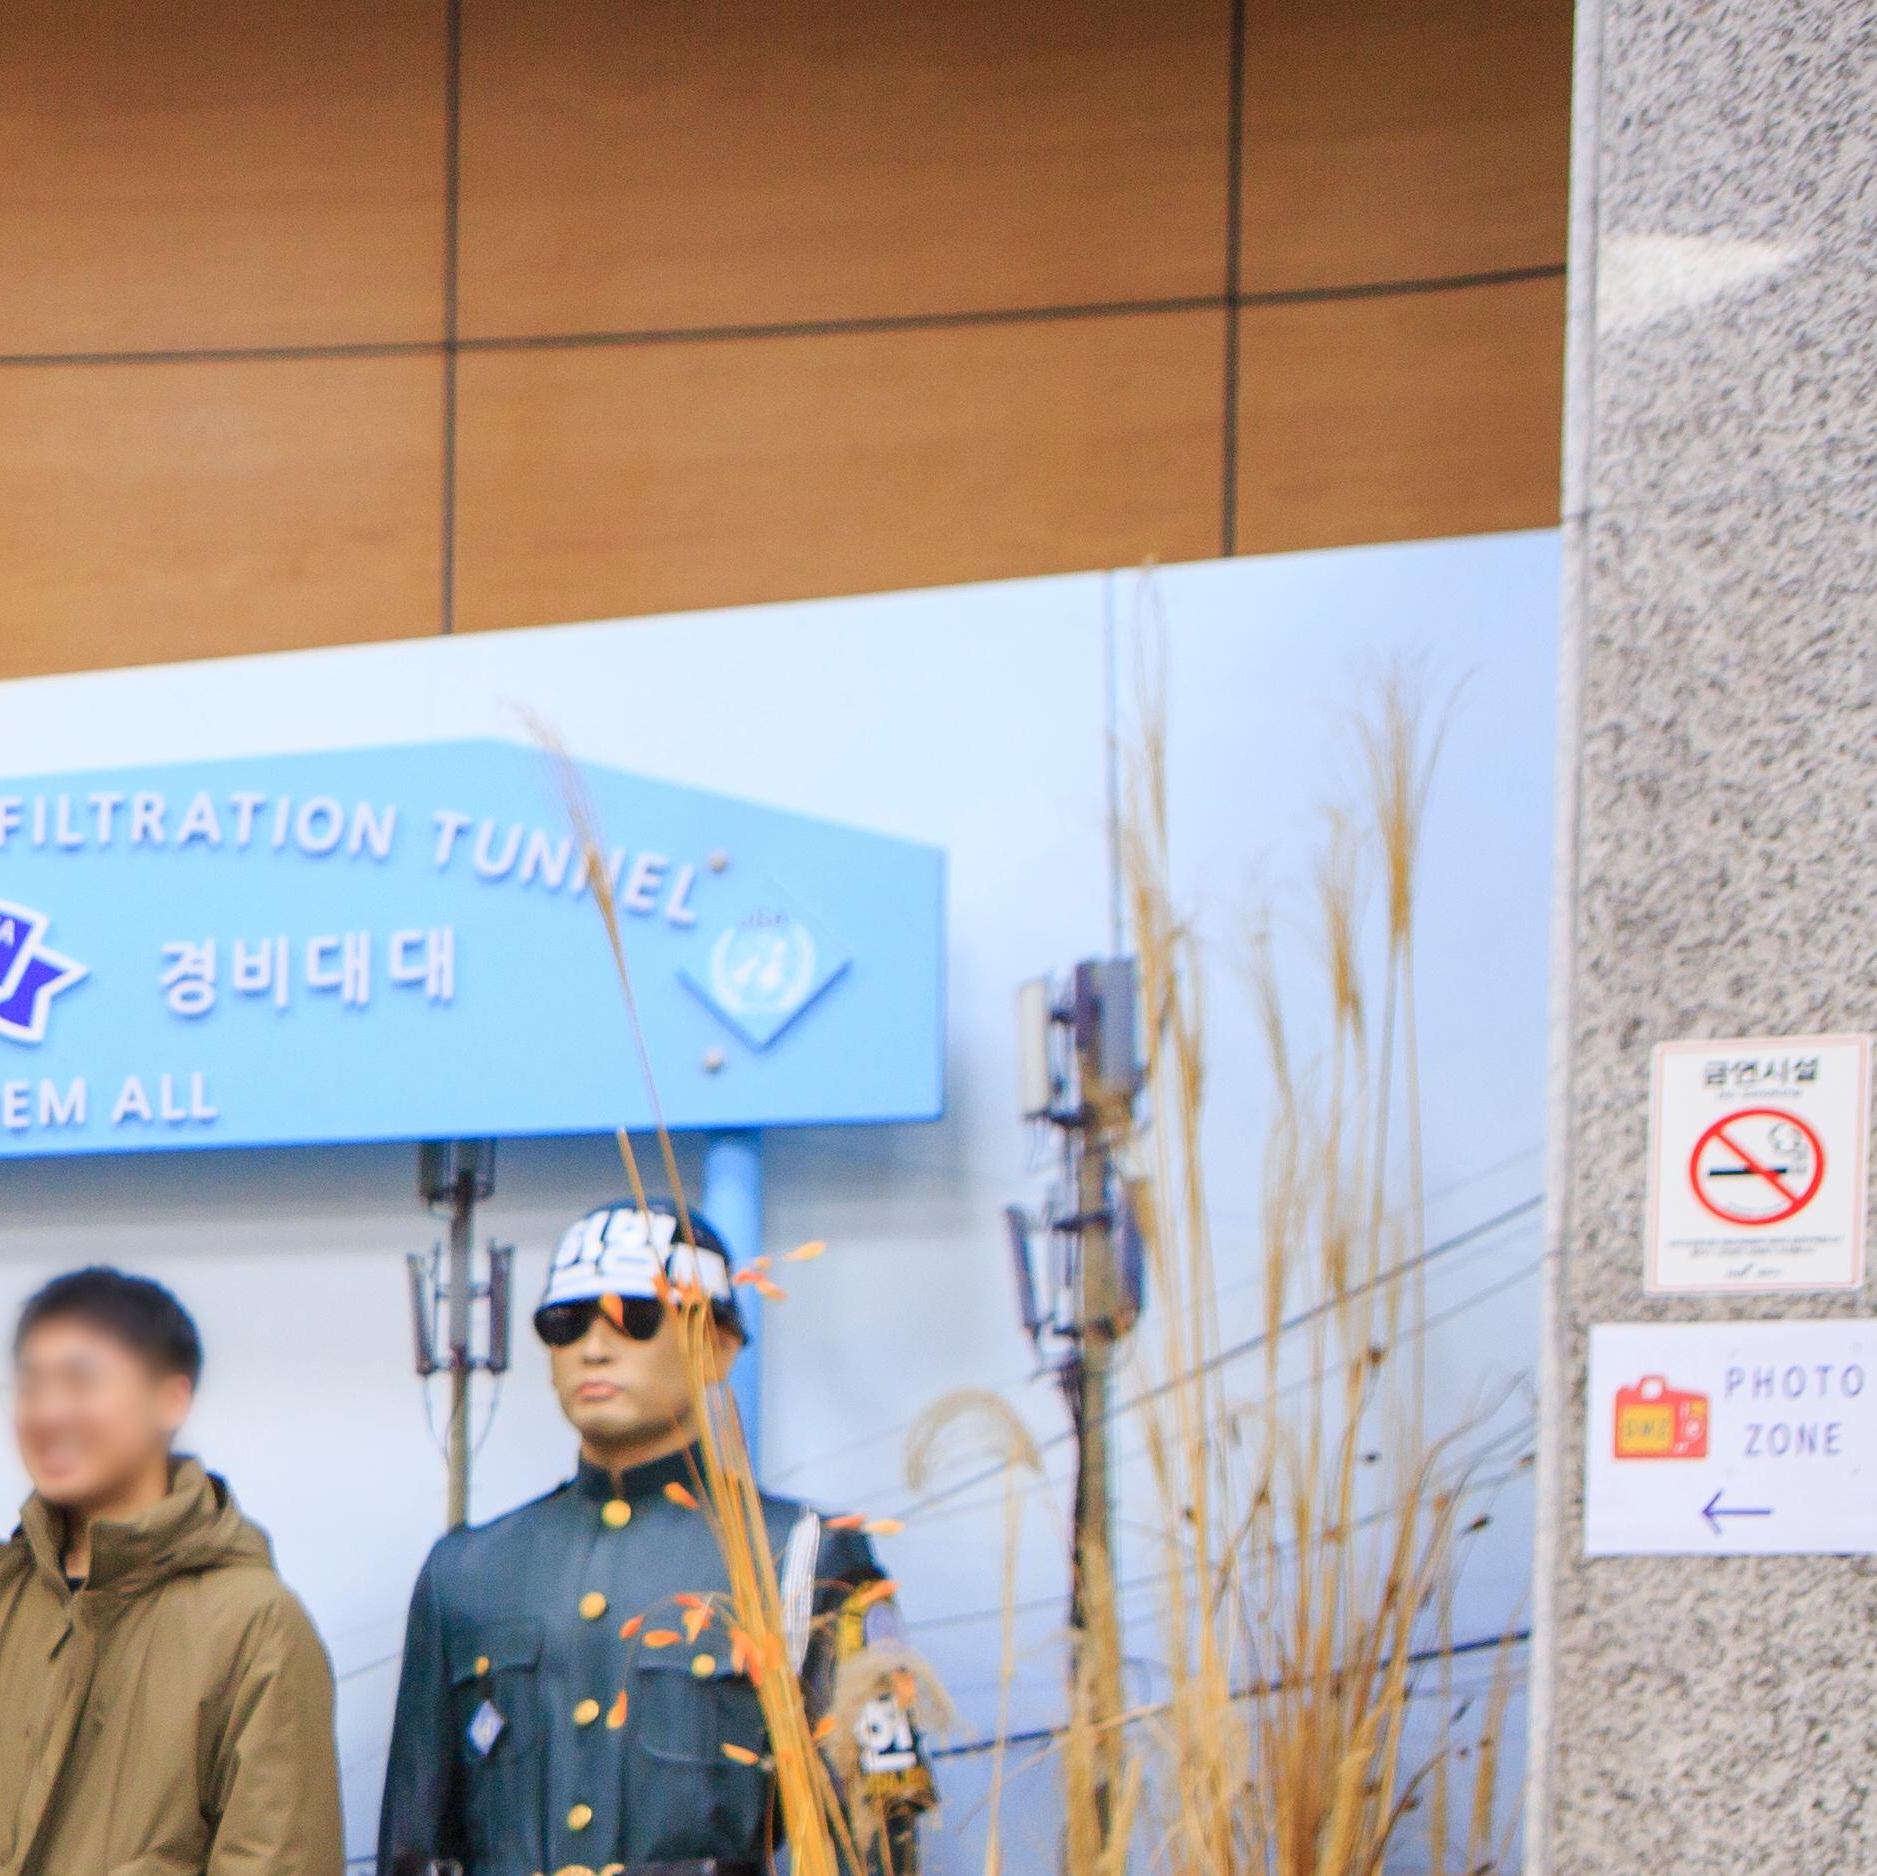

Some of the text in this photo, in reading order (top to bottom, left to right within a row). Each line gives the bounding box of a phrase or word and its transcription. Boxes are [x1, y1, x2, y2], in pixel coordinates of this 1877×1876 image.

[158, 925, 457, 1019] 경비대대
[110, 1072, 219, 1125] ALL
[1724, 1364, 1865, 1400] PHOTO
[1744, 1420, 1844, 1459] ZONE
